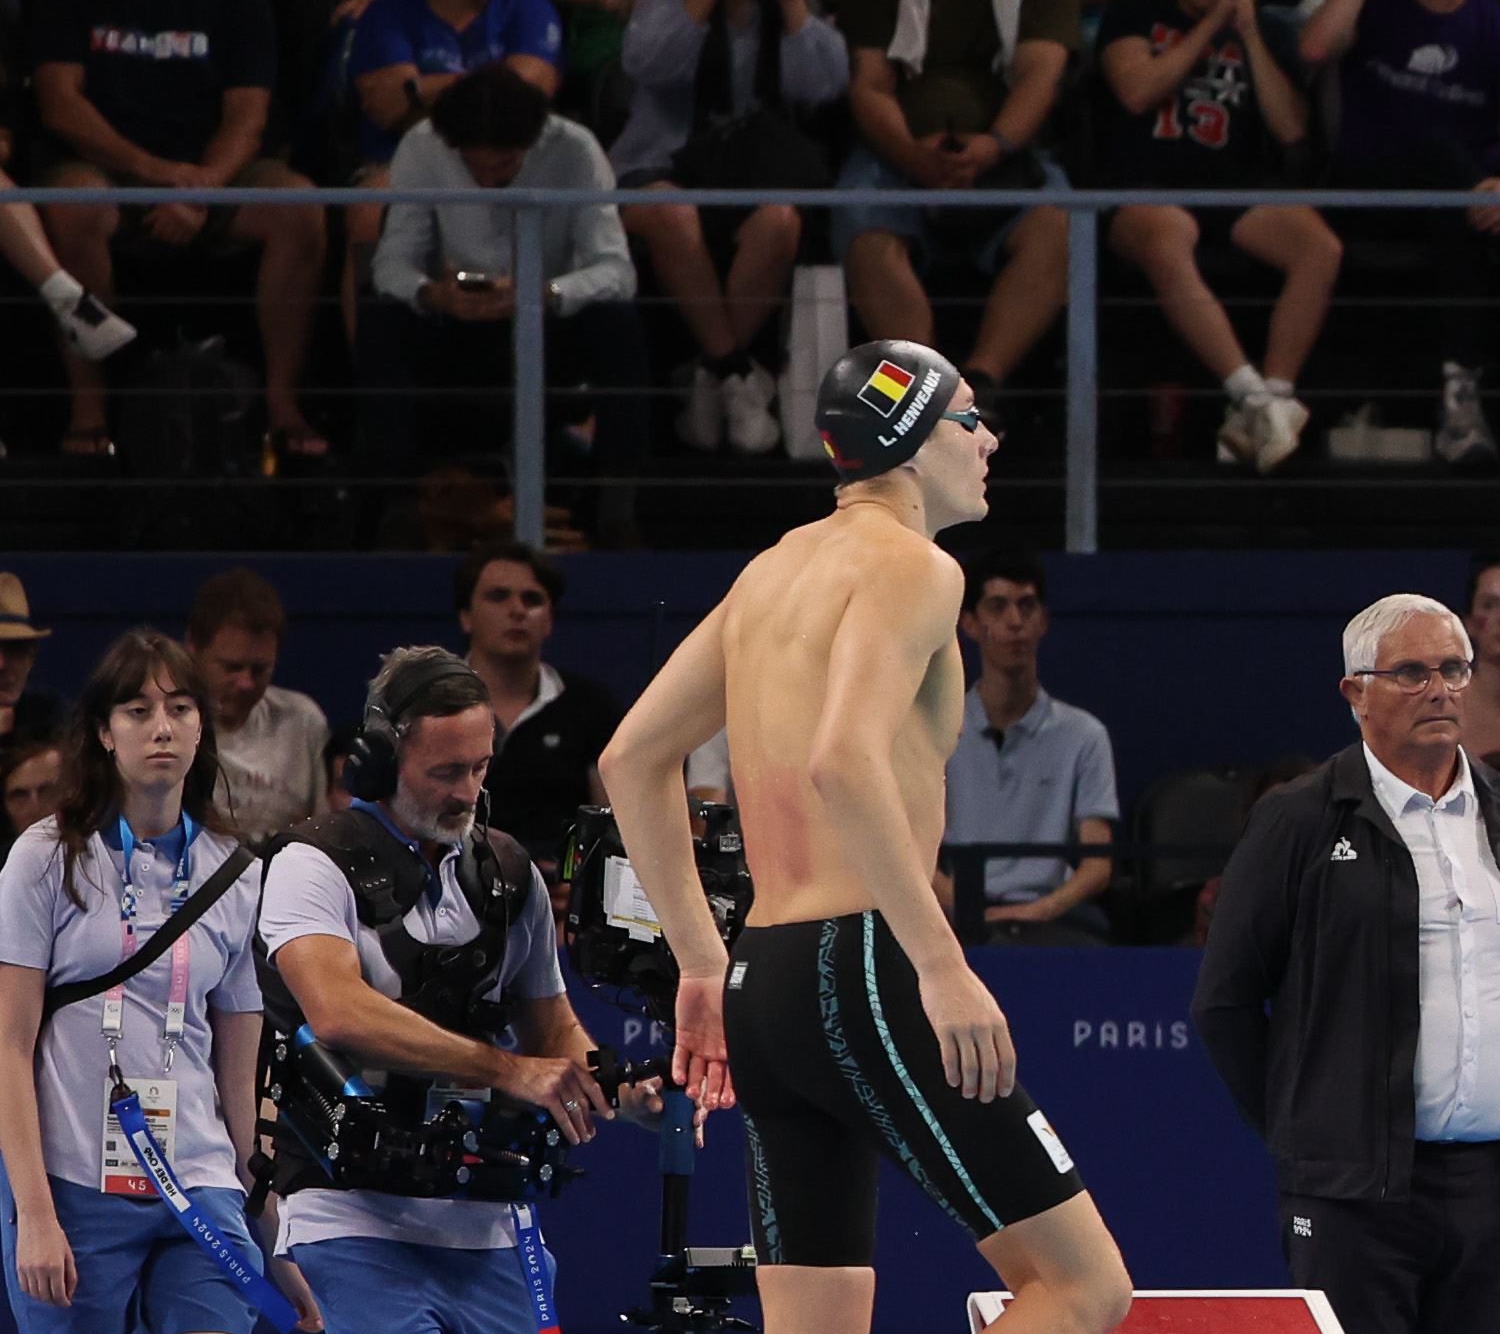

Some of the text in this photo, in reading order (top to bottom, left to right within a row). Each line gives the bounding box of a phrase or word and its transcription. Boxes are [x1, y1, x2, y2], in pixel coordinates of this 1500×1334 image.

[892, 368, 942, 436] HENVEAUX
[1073, 1019, 1189, 1049] PARIS
[217, 1249, 253, 1284] PARIS
[524, 1235, 551, 1323] PARIS 2024
